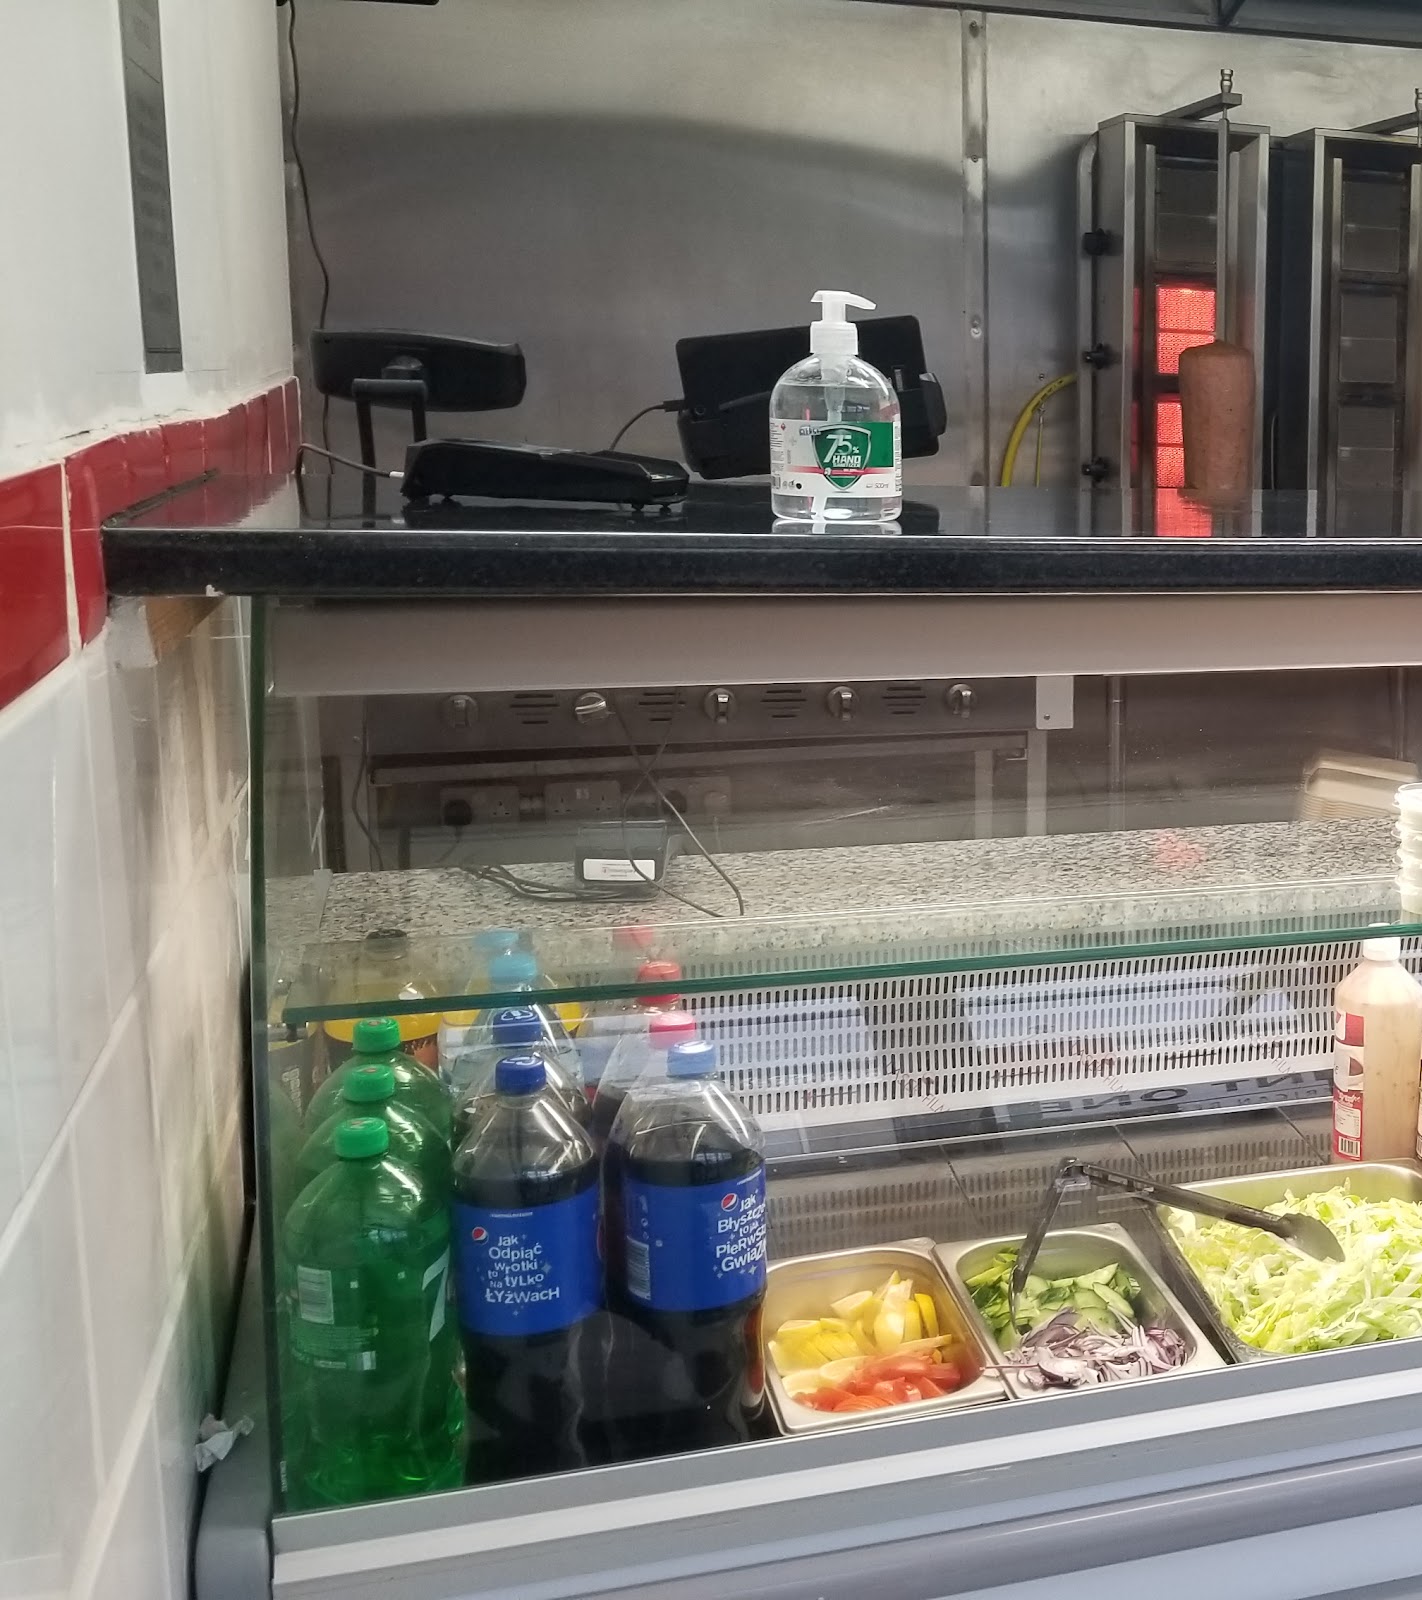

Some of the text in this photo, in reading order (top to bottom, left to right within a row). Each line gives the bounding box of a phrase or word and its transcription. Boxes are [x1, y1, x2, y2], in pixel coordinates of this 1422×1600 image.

[740, 1194, 757, 1212] Jak
[498, 1235, 518, 1247] Jak
[488, 1242, 542, 1262] Odpiąć
[488, 1269, 498, 1279] to
